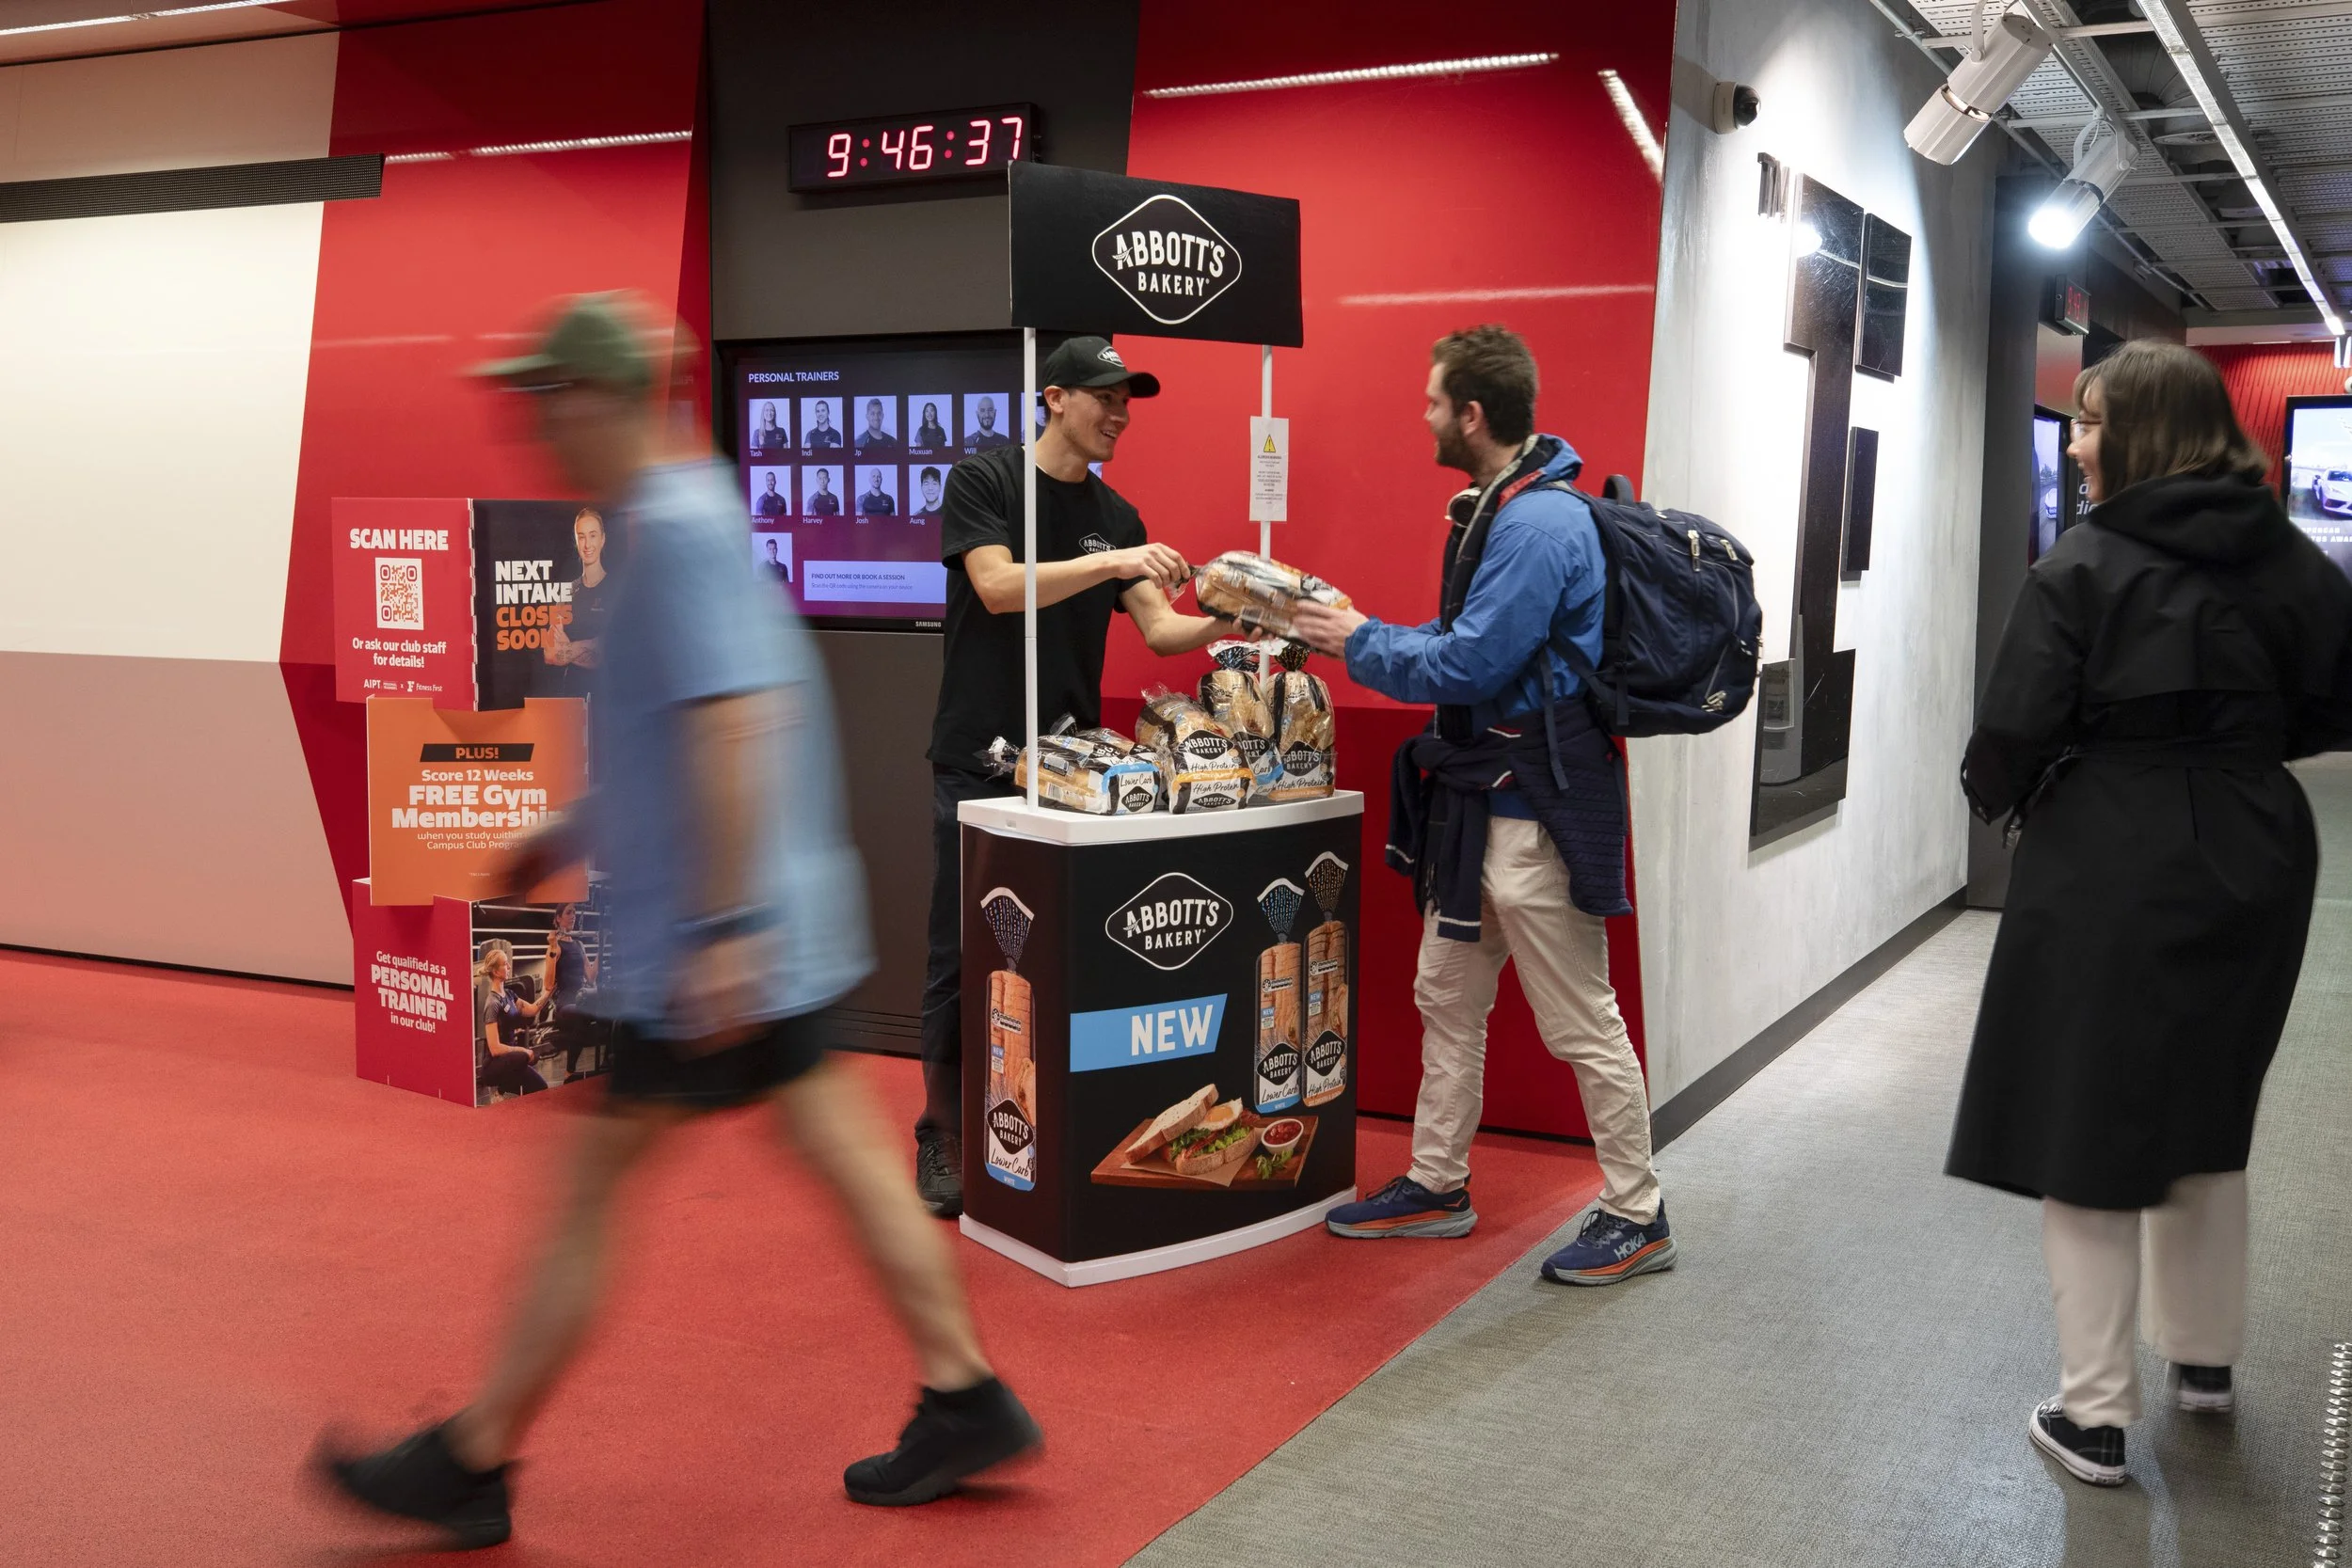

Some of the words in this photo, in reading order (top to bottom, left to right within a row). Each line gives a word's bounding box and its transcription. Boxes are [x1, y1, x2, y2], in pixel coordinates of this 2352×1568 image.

[1112, 230, 1225, 278] ABBOTT'S
[748, 372, 794, 383] PERSONAL
[795, 371, 839, 381] TRAINERS
[910, 517, 925, 526] Aung
[349, 528, 396, 550] SCAN
[399, 529, 449, 551] HERE
[495, 560, 553, 582] NEXT
[496, 582, 573, 605] INTAKE
[496, 605, 574, 628] CLOSES
[352, 637, 364, 650] Or
[365, 638, 381, 651] ask
[382, 641, 399, 652] our
[400, 639, 421, 654] club
[422, 641, 447, 655] staff
[373, 653, 388, 666] for
[389, 654, 425, 668] details!
[363, 678, 381, 689] AIPT
[416, 683, 432, 691] Fitness
[455, 747, 499, 760] PLUS!
[421, 768, 464, 782] Score
[466, 769, 482, 782] 12
[484, 768, 534, 782] Weeks
[1120, 774, 1138, 787] Lower
[408, 784, 479, 806] FREE
[483, 784, 548, 810] Gym
[391, 806, 564, 829] Membershi
[417, 832, 444, 840] when
[446, 832, 464, 842] you
[465, 831, 491, 842] study
[426, 840, 465, 851] Campus
[466, 840, 486, 849] Club
[1123, 898, 1220, 939] ABBOTT'S
[376, 950, 391, 964] Get
[392, 956, 429, 972] qualified
[429, 963, 439, 974] as
[440, 966, 447, 975] a
[371, 964, 453, 1001] PERSONAL
[377, 988, 448, 1022] TRAINER
[1310, 993, 1321, 1002] NEW
[1263, 1007, 1274, 1016] NEW
[390, 1012, 399, 1024] in
[400, 1015, 414, 1028] our
[415, 1018, 437, 1033] club!
[1130, 1004, 1214, 1057] NEW
[993, 1046, 1005, 1059] NEW
[1310, 1040, 1343, 1064] ABBOTT'S
[1262, 1052, 1298, 1073] ABBOTT'S
[1317, 1055, 1337, 1069] BAKERY
[1270, 1067, 1292, 1079] BAKERY
[1262, 1088, 1282, 1103] Lower
[993, 1112, 1029, 1140] ABBOTT'S
[999, 1130, 1022, 1147] BAKERY
[991, 1149, 1012, 1170] Lower
[1012, 1157, 1029, 1177] Carb
[1613, 1232, 1646, 1260] HOKA
